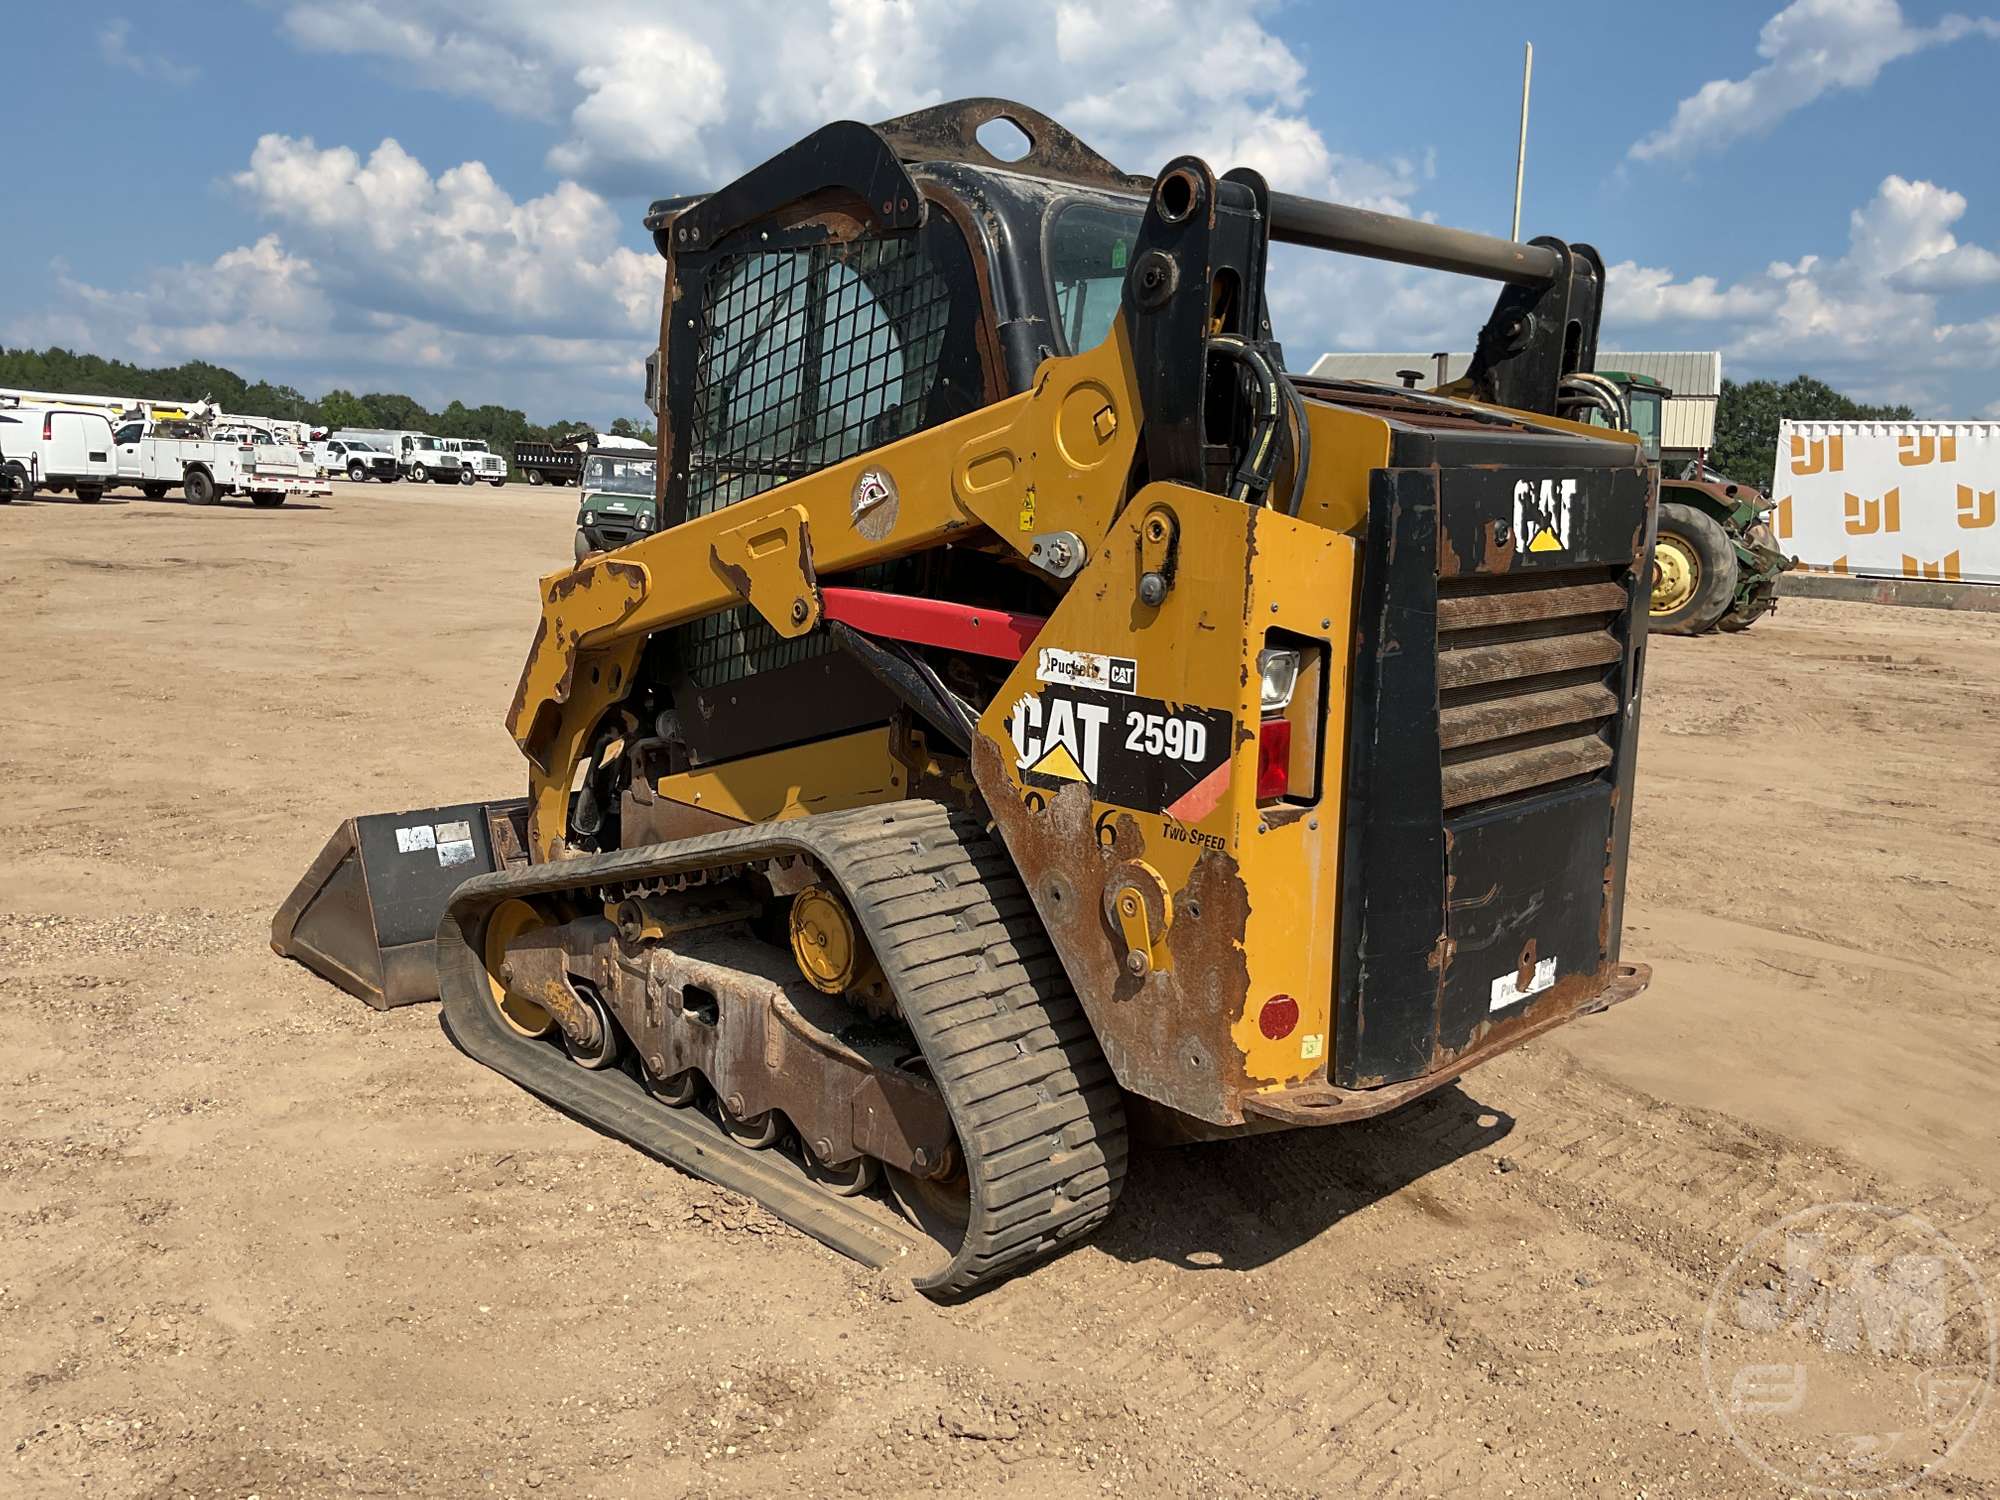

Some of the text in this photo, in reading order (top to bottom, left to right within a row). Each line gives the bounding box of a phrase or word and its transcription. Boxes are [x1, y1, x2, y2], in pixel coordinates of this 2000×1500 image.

[1111, 666, 1134, 685] CAT
[1011, 692, 1207, 785] CAT 259D
